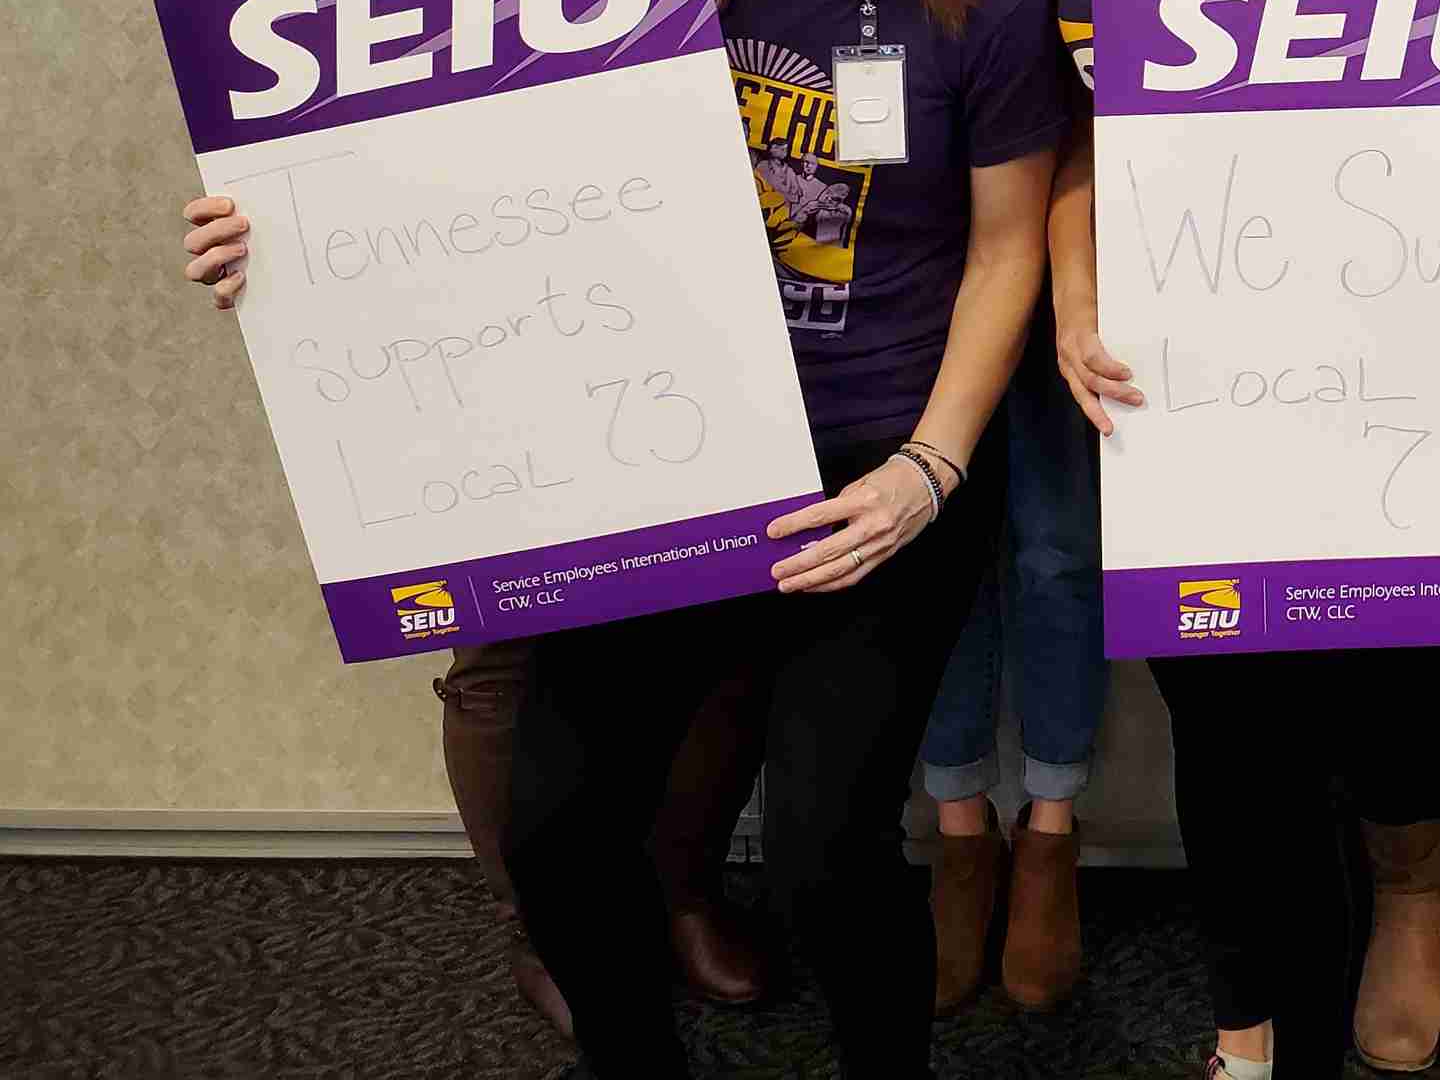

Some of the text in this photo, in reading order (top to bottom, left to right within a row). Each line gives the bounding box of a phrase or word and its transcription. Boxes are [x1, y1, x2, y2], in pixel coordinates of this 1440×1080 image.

[224, 151, 664, 285] Tennessee
[1127, 152, 1289, 295] We
[584, 370, 706, 467] 73
[492, 533, 758, 594] Service Employees International Union
[498, 588, 565, 611] CTW, CLC
[1285, 585, 1336, 601] Service
[1339, 583, 1416, 602] Employees
[400, 607, 455, 633] SEIU
[1178, 610, 1240, 631] SEIU
[1286, 604, 1355, 621] CTW, CLC
